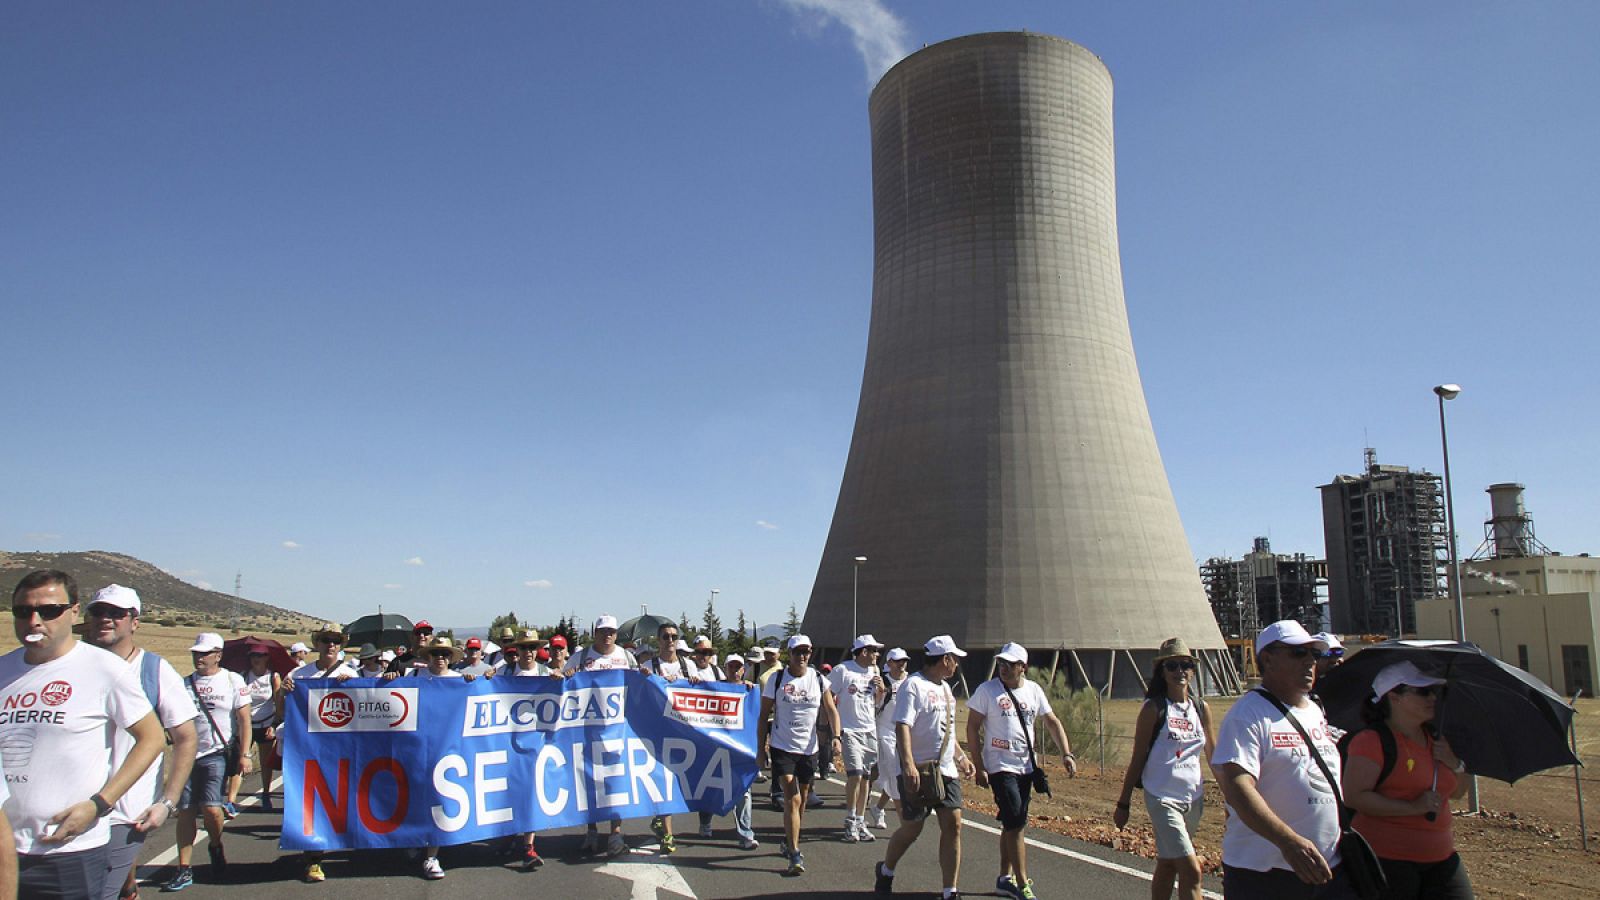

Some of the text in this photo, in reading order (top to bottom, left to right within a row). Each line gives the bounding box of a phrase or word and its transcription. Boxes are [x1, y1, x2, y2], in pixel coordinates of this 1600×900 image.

[4, 692, 37, 709] NO
[323, 698, 351, 712] UGT
[358, 702, 390, 712] FITAG
[675, 695, 719, 711] CCOO
[0, 710, 66, 724] CIERRE
[1291, 747, 1306, 758] AL
[303, 737, 732, 836] NO SE CIERRA
